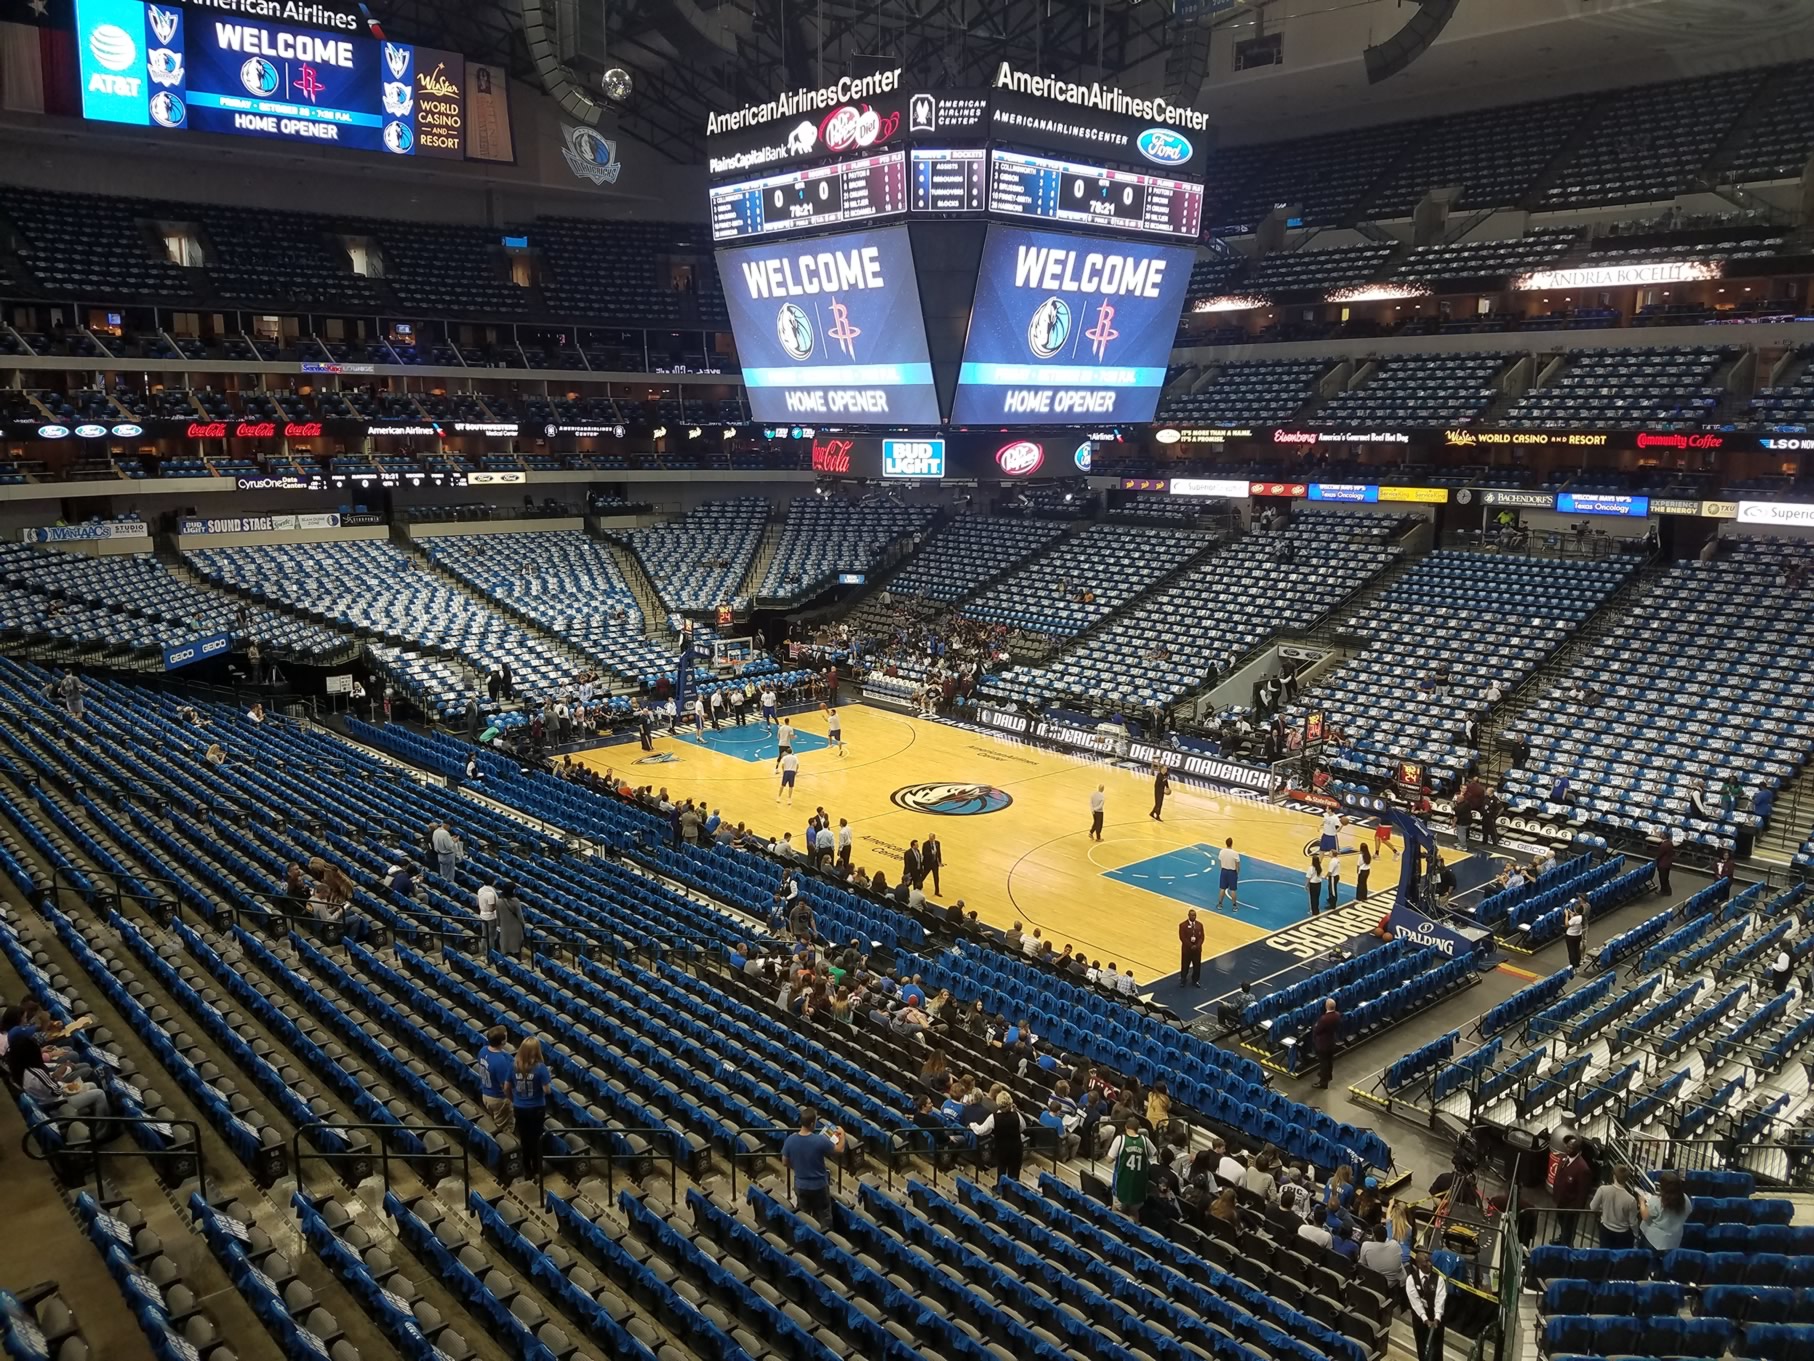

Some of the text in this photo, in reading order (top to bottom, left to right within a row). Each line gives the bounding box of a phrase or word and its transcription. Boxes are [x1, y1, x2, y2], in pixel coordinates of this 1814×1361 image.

[182, 0, 357, 30] merican Airlines
[215, 22, 353, 68] WELCOME
[89, 73, 141, 97] AT&T
[417, 65, 459, 97] WinStar
[420, 100, 459, 115] WORLD
[938, 100, 986, 108] AMERICAN
[418, 112, 460, 127] CASINO
[938, 108, 981, 117] AIRLINES
[235, 113, 339, 139] HOME OPENER
[432, 127, 447, 135] AND
[420, 135, 459, 149] RESORT
[1149, 133, 1181, 160] Ford
[774, 181, 829, 208] 0 0
[799, 190, 804, 199] 1
[1074, 179, 1084, 198] 0
[1123, 187, 1133, 205] 0
[1102, 188, 1107, 197] 1
[742, 246, 884, 299] WELCOME
[1015, 245, 1167, 298] WELCOME
[1550, 265, 1683, 287] ANDREA BOCELLI
[785, 389, 888, 412] HOME OPENER
[1004, 389, 1116, 413] HOME OPENER
[368, 426, 434, 435] American Airlines
[1091, 433, 1114, 441] Airlines
[1274, 429, 1409, 444] Eisenberg America's Gourmet Beef Hot Dog
[1445, 429, 1476, 445] WinStar
[1478, 434, 1511, 443] WORLD
[1512, 434, 1549, 443] CASINO
[1569, 435, 1607, 445] RESORT
[1637, 433, 1724, 449] Community Coffee
[1770, 439, 1799, 449] LSO
[893, 443, 932, 459] BUD
[886, 458, 941, 474] LIGHT
[238, 479, 282, 490] CyrusOne
[1337, 492, 1365, 500] Oncology
[1498, 493, 1553, 503] BACHENDORF'S
[1574, 502, 1629, 513] Texas Oncology
[1651, 500, 1698, 508] EXPERIENCE
[183, 526, 206, 534] LIGHT
[208, 518, 241, 533] SOUND
[242, 517, 272, 531] STAGE
[202, 640, 227, 653] GEICO
[169, 649, 194, 663] GEICO
[992, 711, 1036, 734] DALLA
[1517, 844, 1546, 854] GEICO
[1394, 924, 1454, 956] SPALDING
[1126, 1154, 1142, 1171] 41
